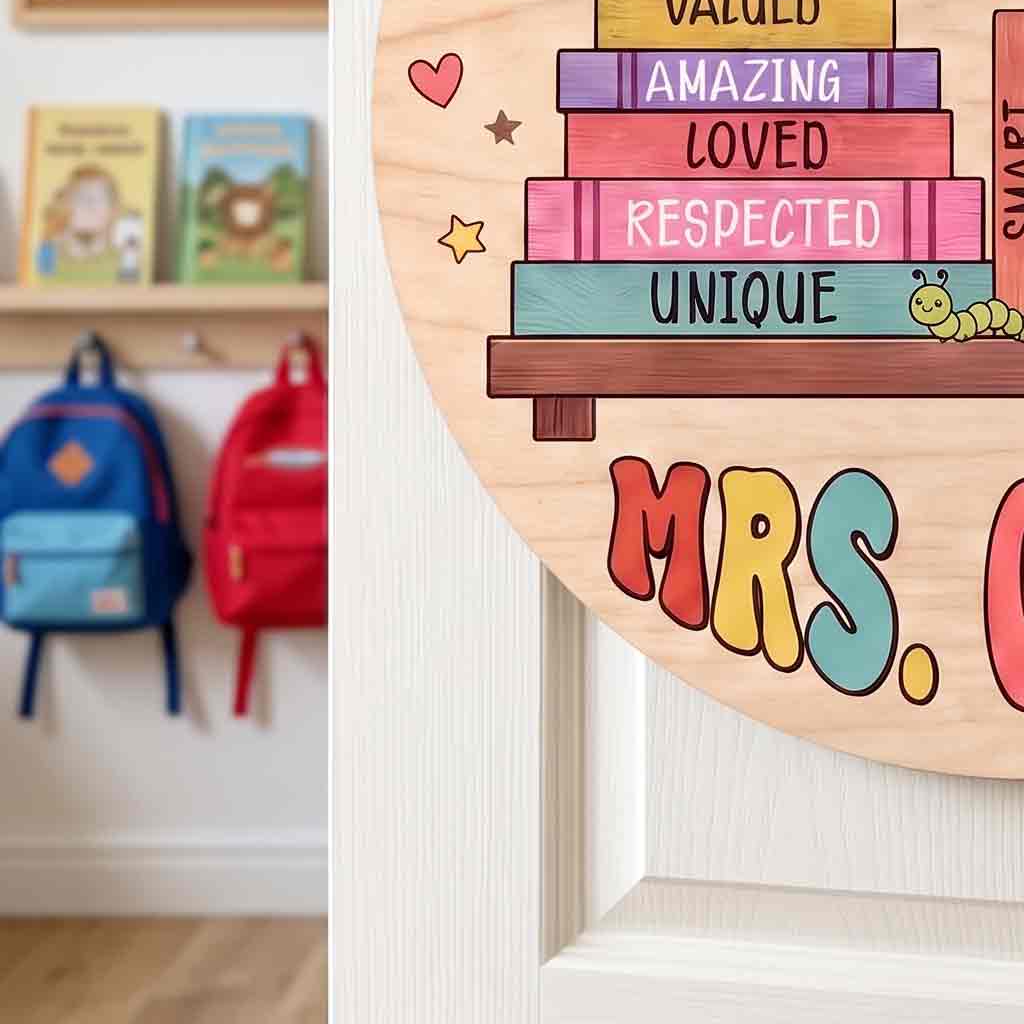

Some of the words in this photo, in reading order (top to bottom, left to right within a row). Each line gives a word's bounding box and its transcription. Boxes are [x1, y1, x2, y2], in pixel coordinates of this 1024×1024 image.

[645, 58, 842, 103] AMAZING
[686, 119, 829, 170] LOVED
[625, 198, 882, 249] RESPECTED
[650, 269, 837, 329] UNIQUE
[608, 456, 939, 705] MRS.
